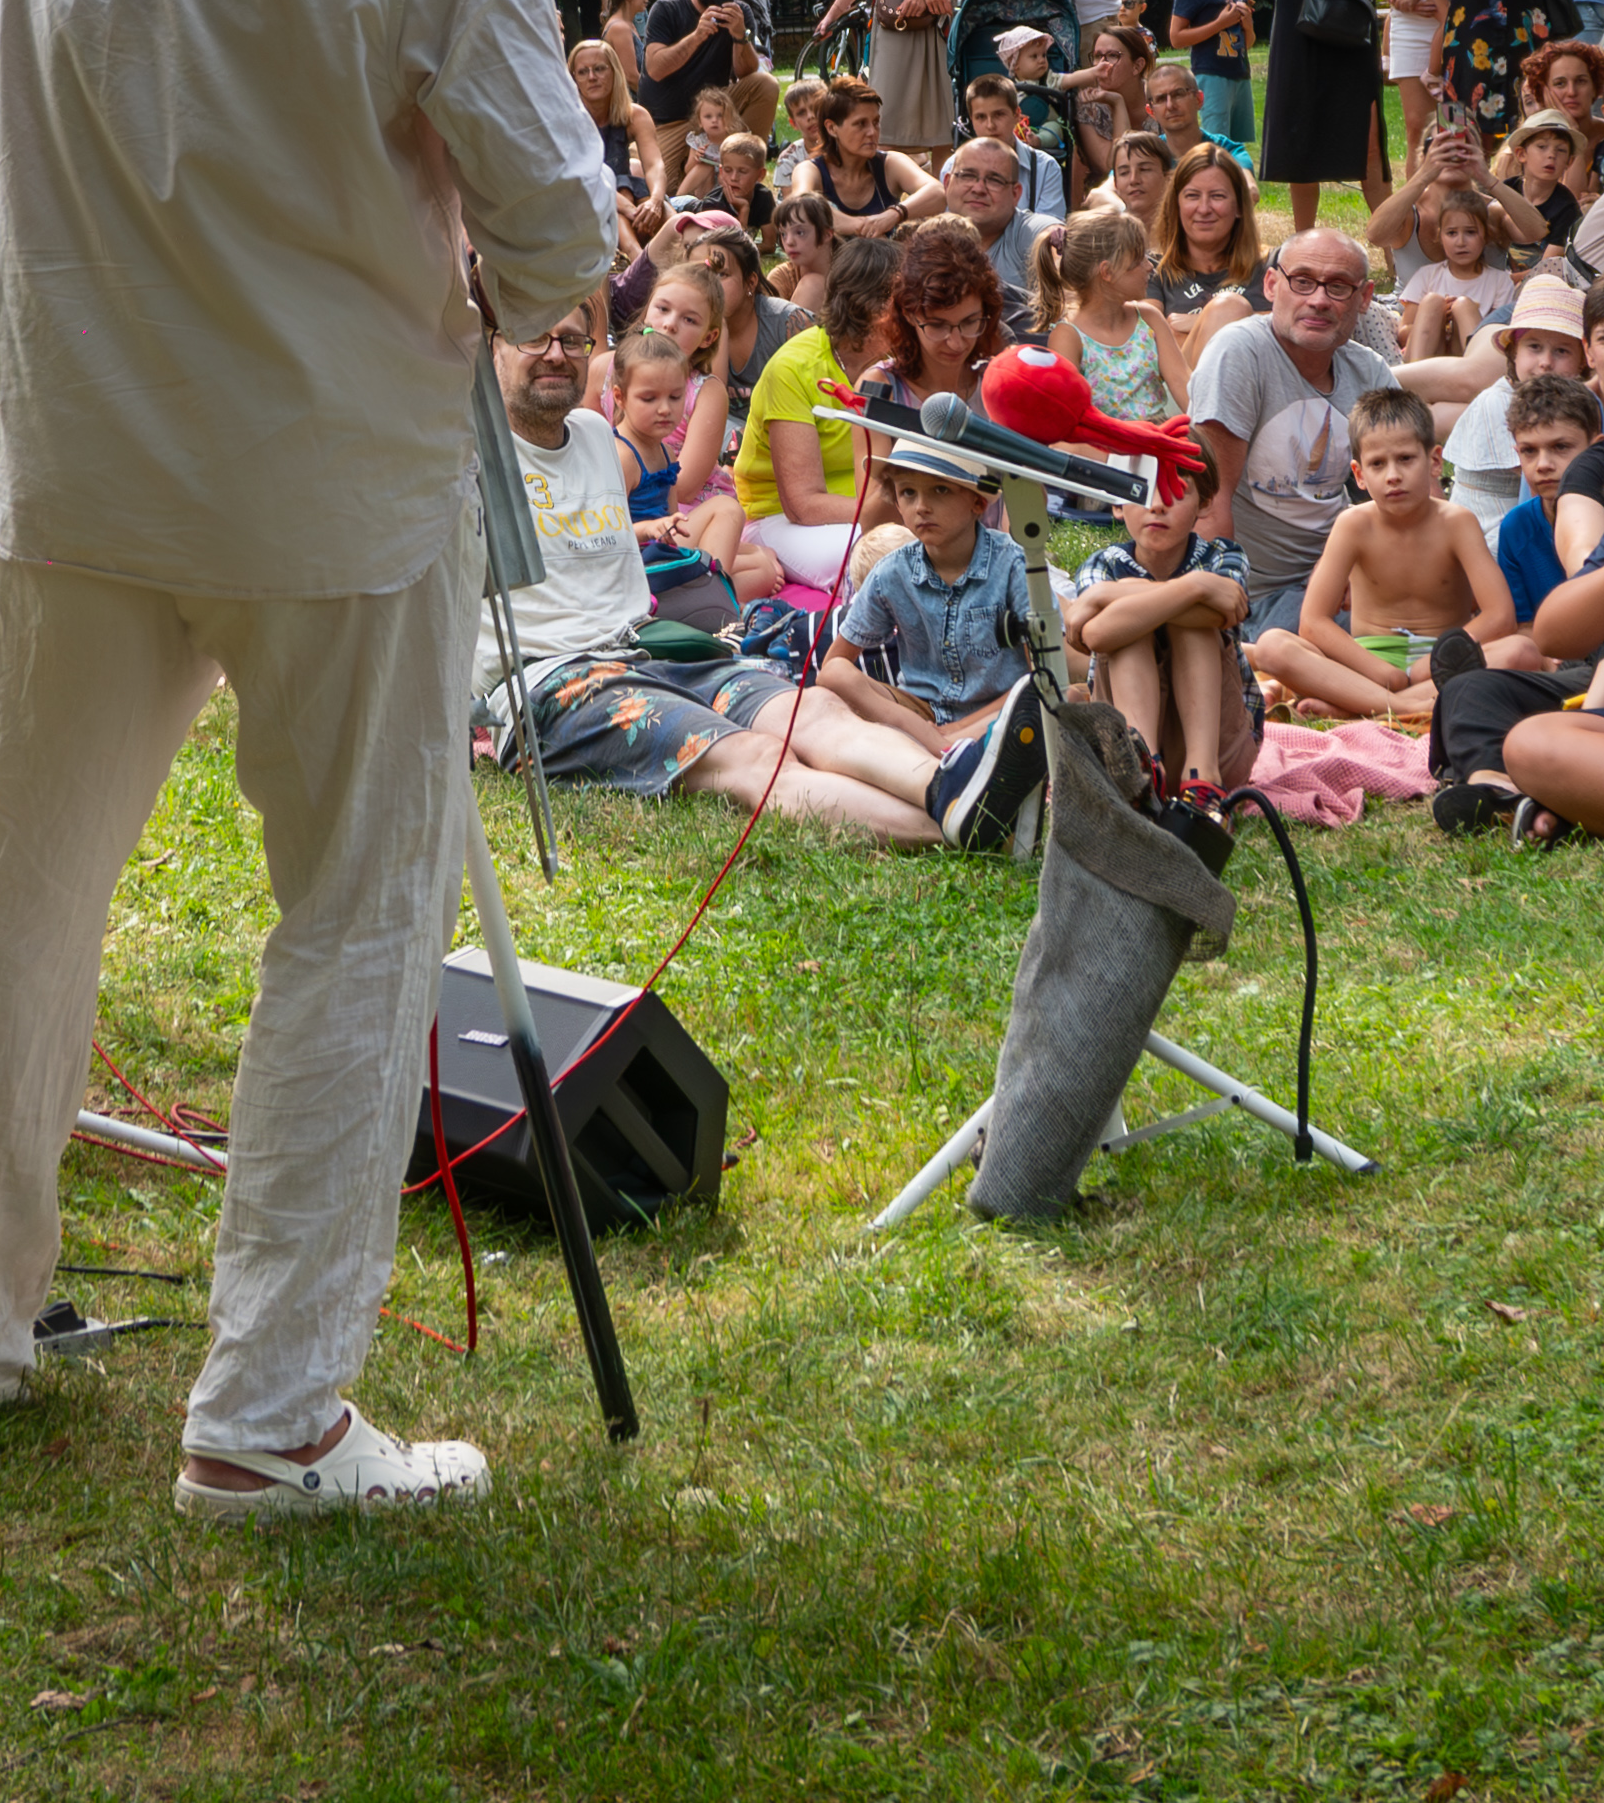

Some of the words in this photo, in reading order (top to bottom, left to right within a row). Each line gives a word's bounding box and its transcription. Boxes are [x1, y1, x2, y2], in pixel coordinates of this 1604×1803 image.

[525, 473, 555, 510] 3
[535, 504, 631, 539] ONDON
[590, 534, 617, 549] JEANS
